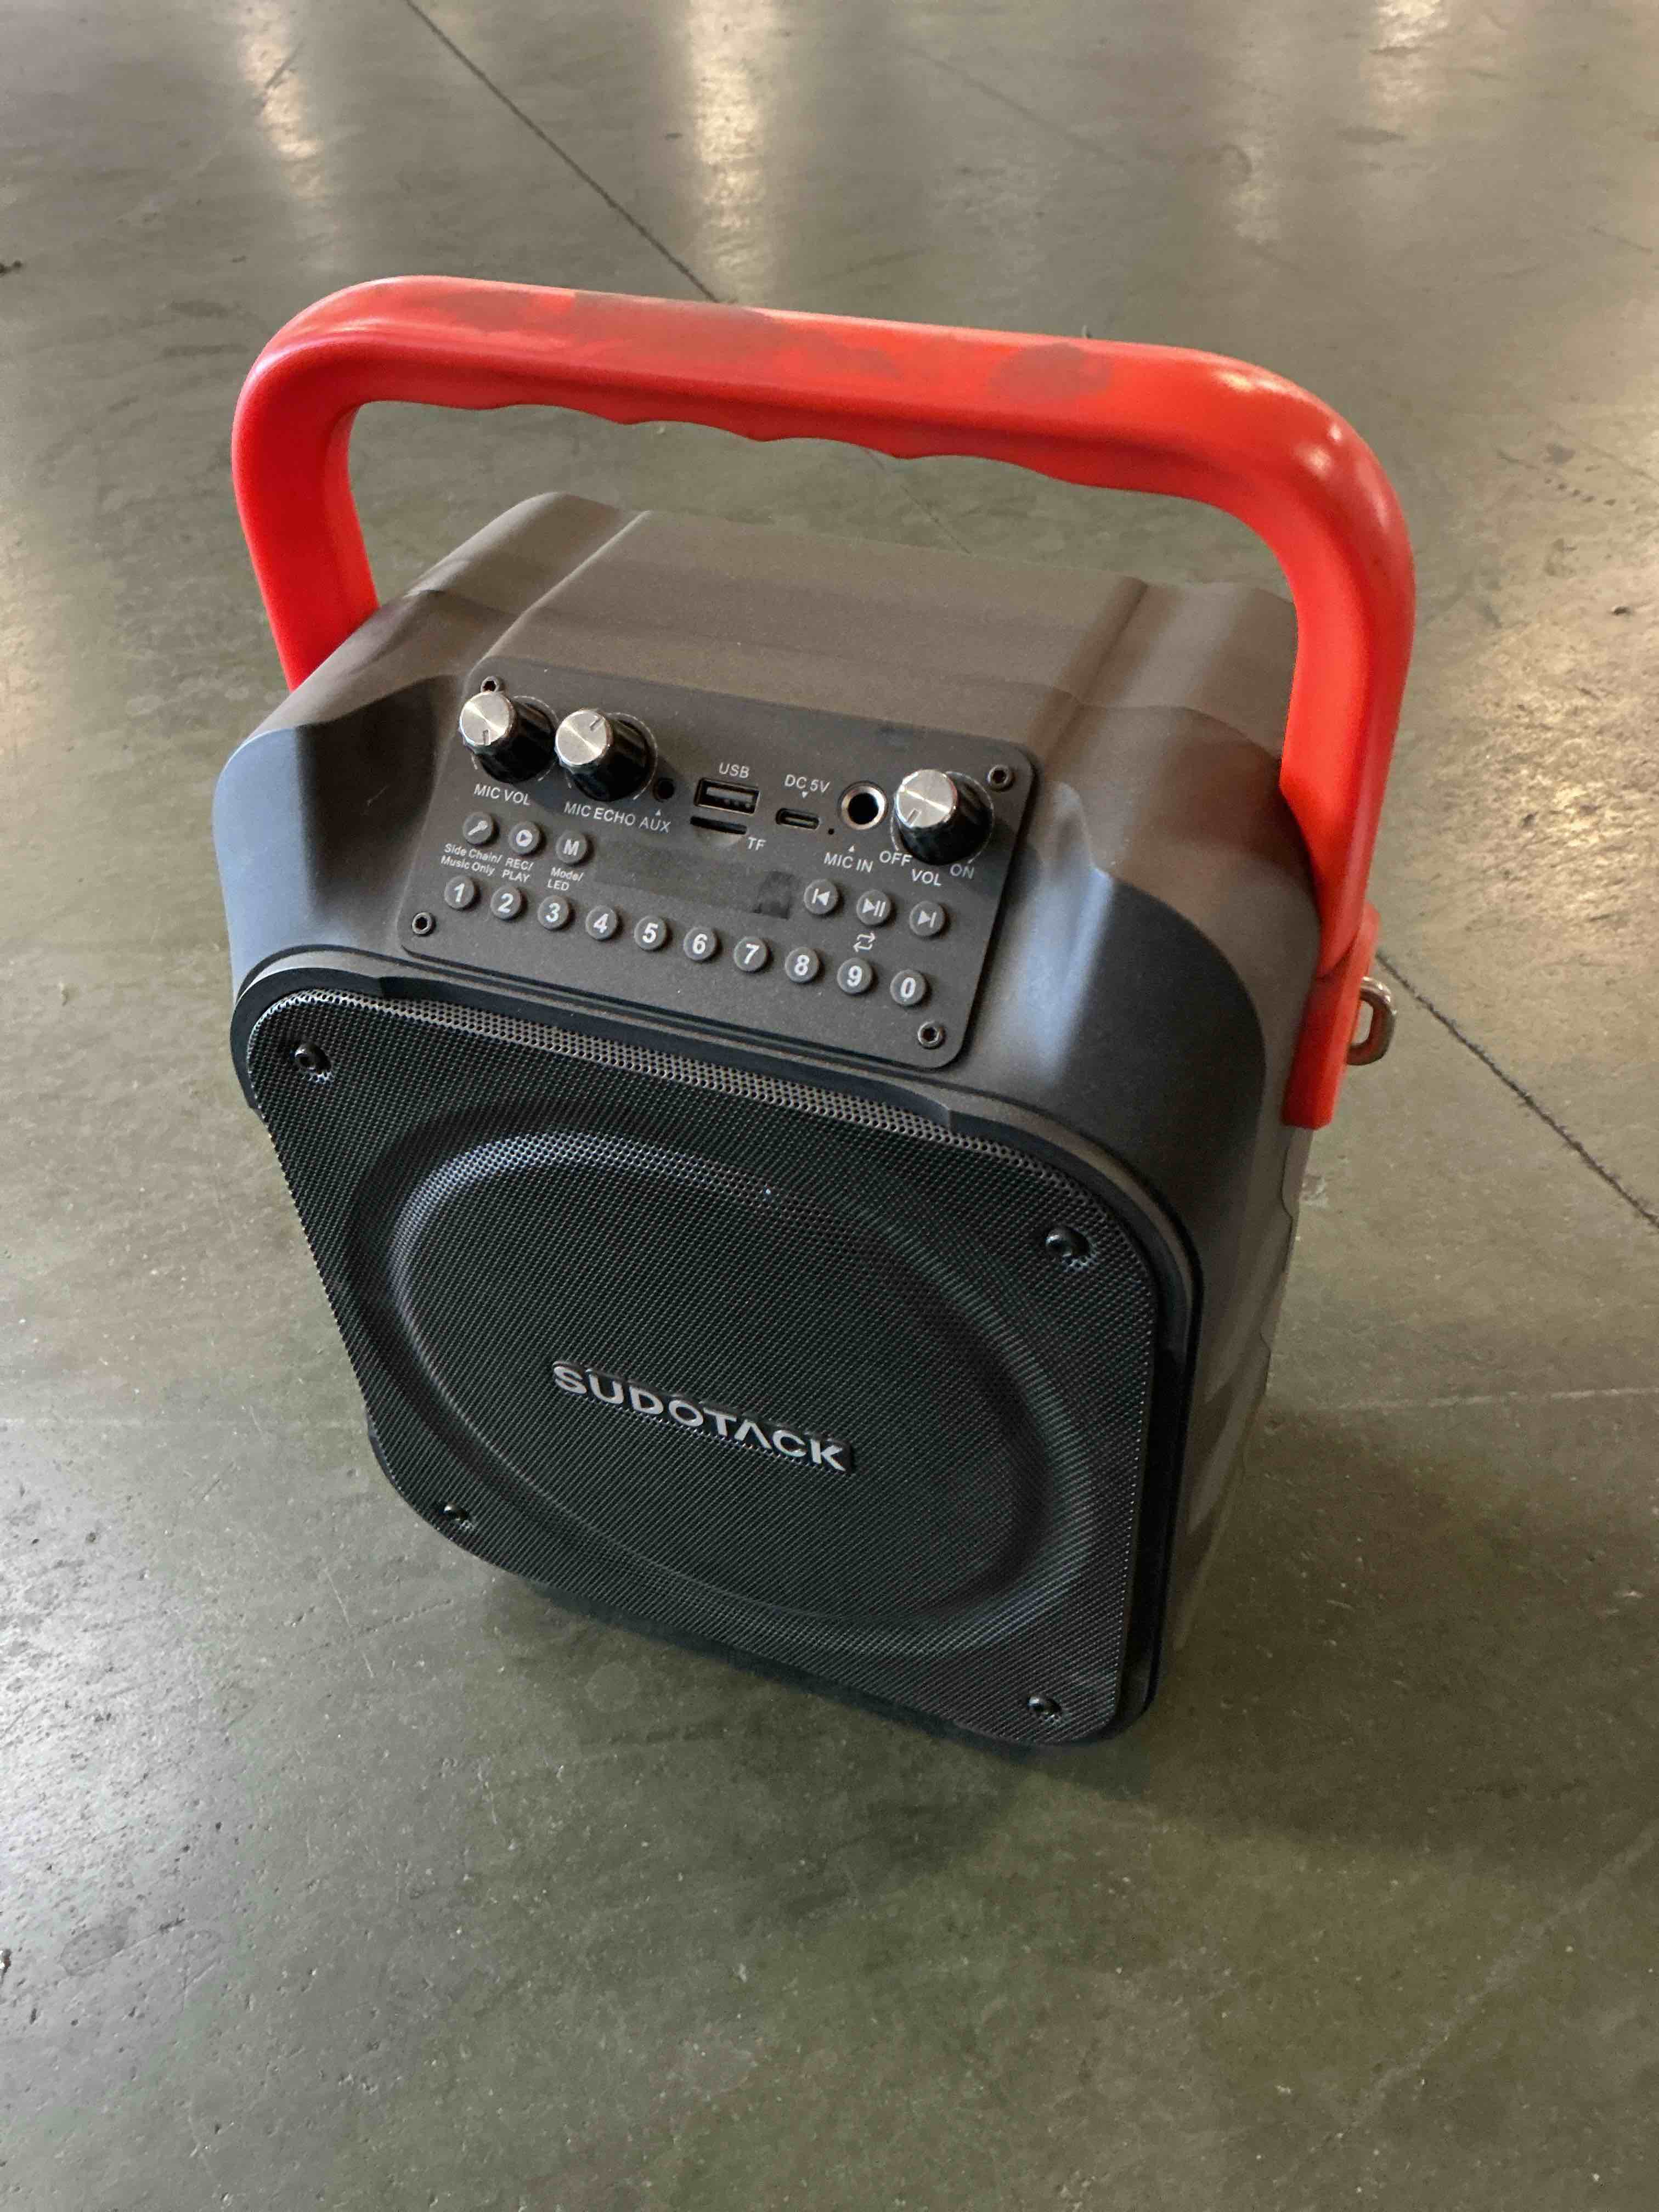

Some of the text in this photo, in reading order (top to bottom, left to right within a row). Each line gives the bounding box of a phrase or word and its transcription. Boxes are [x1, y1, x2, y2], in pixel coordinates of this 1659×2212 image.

[719, 762, 750, 778] USB
[473, 783, 531, 805] MIC VOL
[563, 802, 636, 826] MIC ECHO
[639, 816, 672, 834] AUX
[444, 843, 503, 864] Side Chain/
[563, 839, 579, 856] M
[748, 837, 766, 851] TF
[441, 855, 496, 877] Music Only
[505, 857, 534, 871] REC/
[823, 851, 874, 873] MIC IN
[879, 850, 913, 866] OFF
[502, 869, 531, 883] PLAY
[550, 867, 584, 882] Mode/
[911, 868, 942, 887] VOL
[950, 864, 974, 879] ON
[454, 883, 465, 903] 1
[547, 879, 569, 891] LED
[498, 893, 514, 913] 2
[545, 902, 561, 922] 3
[593, 913, 610, 934] 4
[642, 922, 658, 943] 5
[692, 933, 707, 954] 6
[744, 943, 759, 964] 7
[794, 955, 810, 976] 8
[847, 965, 862, 987] 9
[900, 977, 915, 998] 0
[553, 1365, 846, 1472] SUDOTACK
